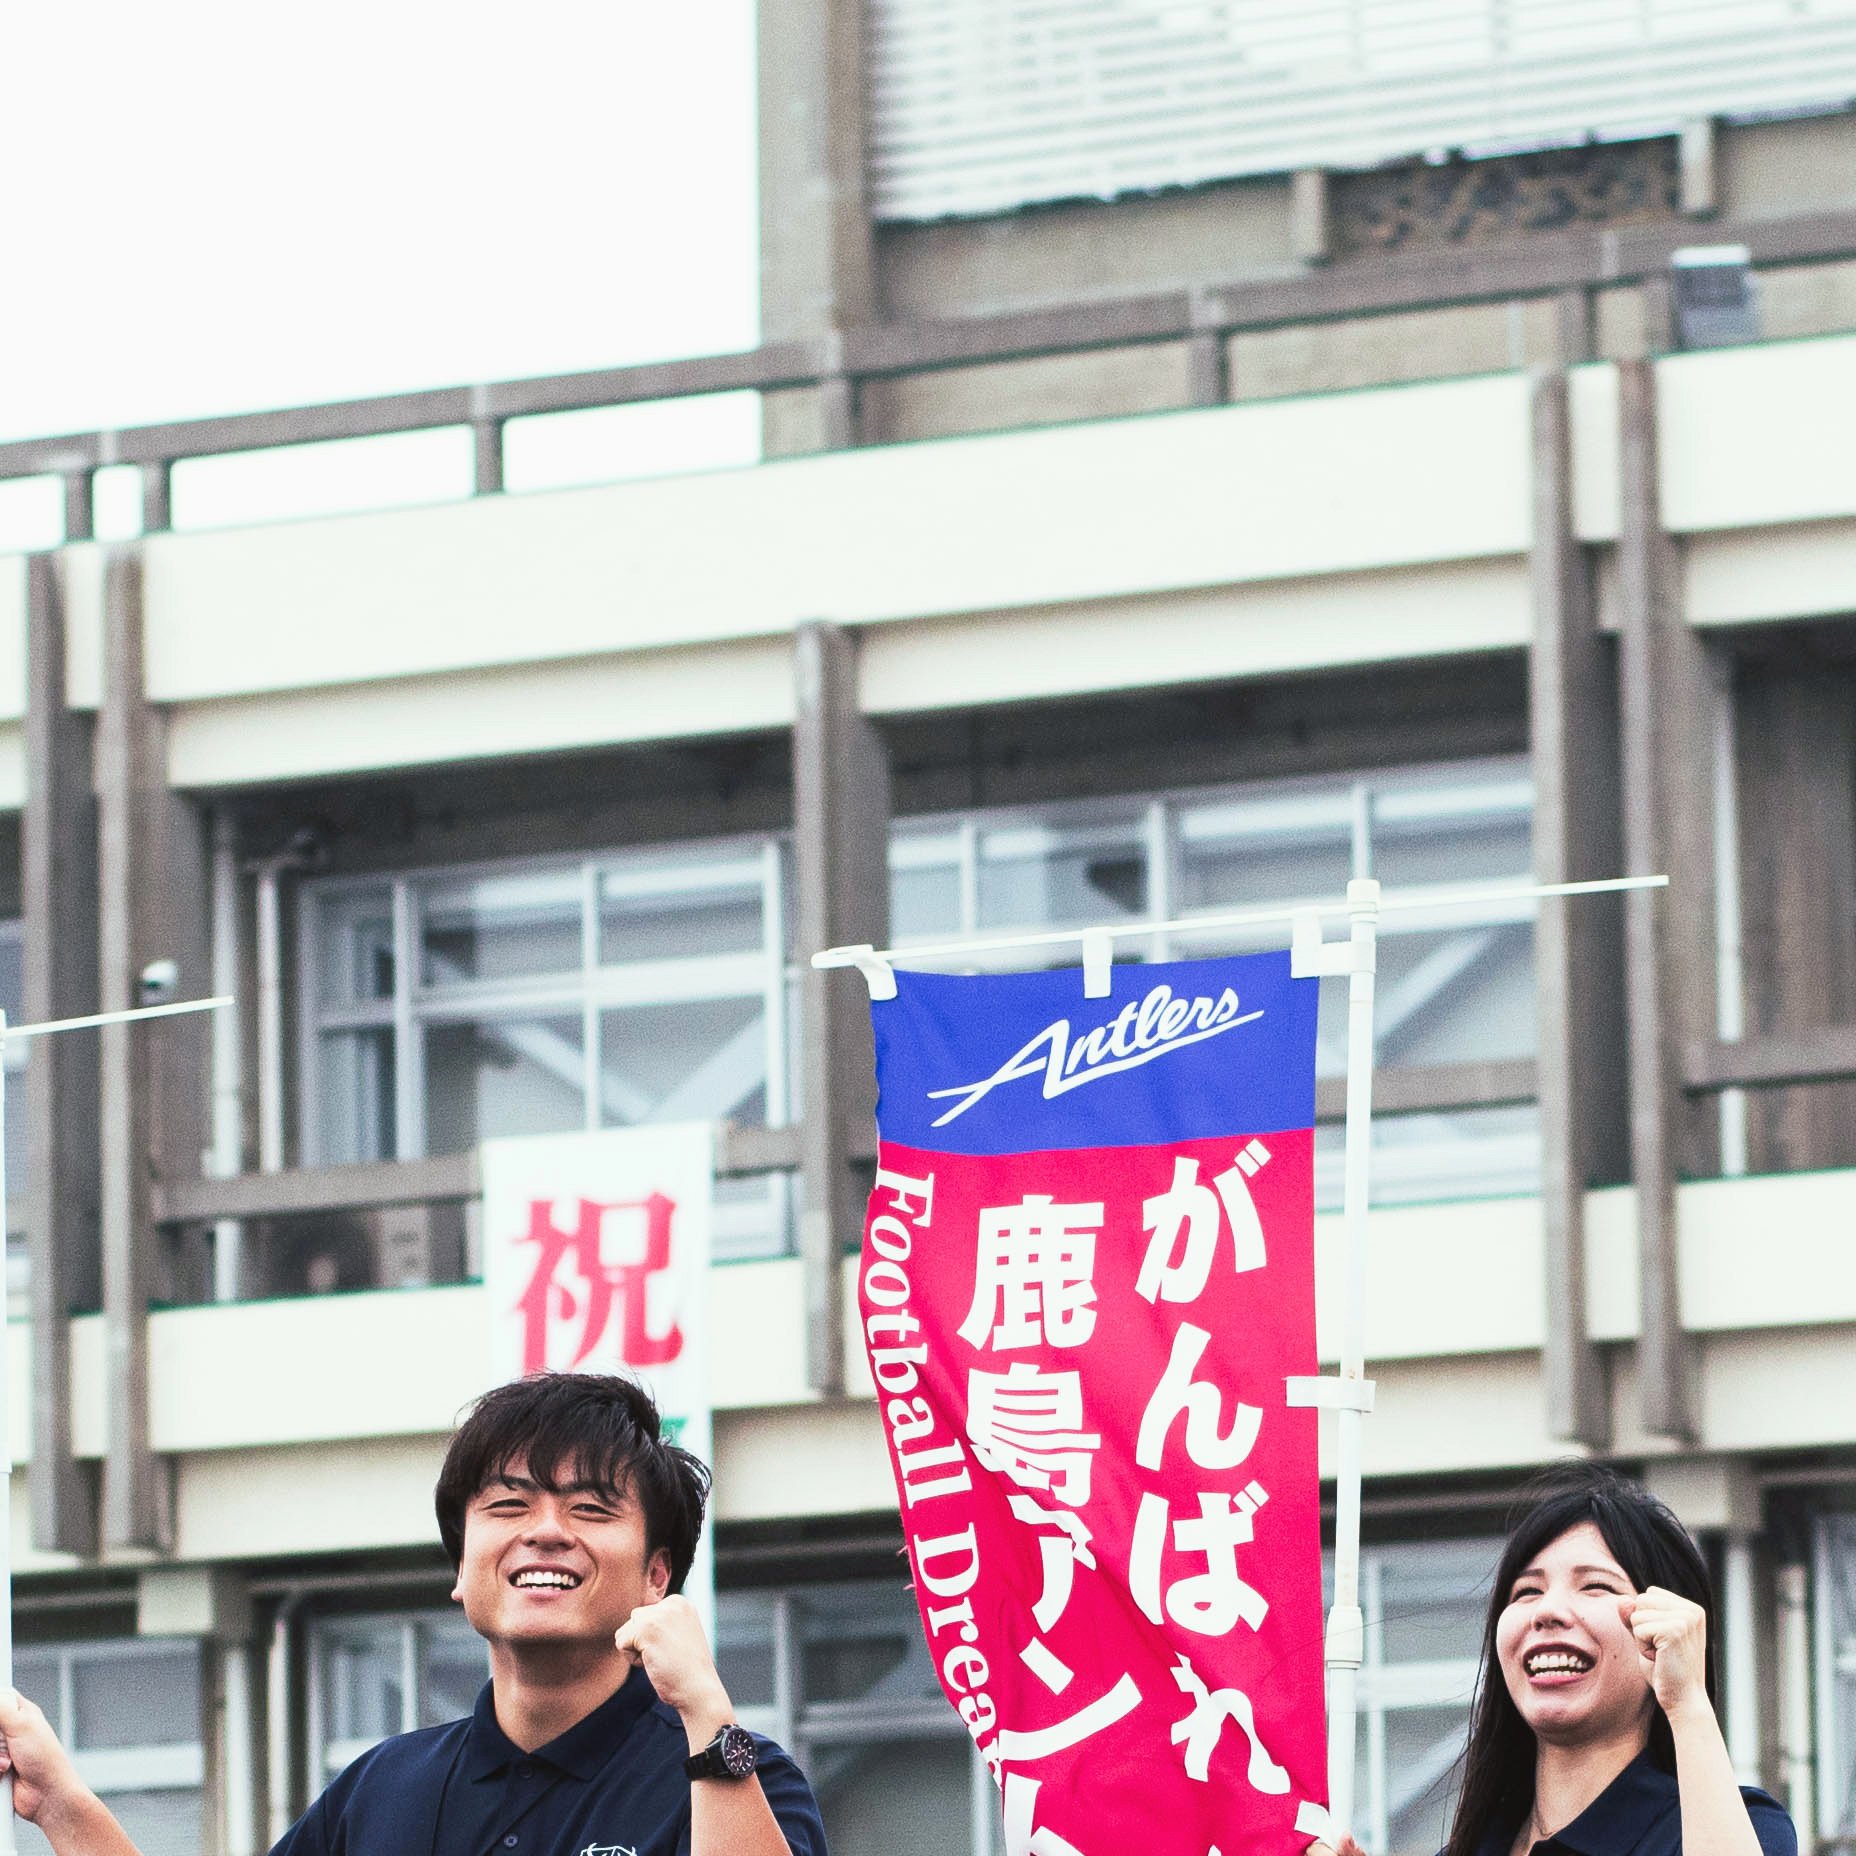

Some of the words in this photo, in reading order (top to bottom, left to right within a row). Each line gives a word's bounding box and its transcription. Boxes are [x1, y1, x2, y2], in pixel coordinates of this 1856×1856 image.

[926, 984, 1265, 1128] Antlers
[509, 1191, 684, 1377] 祝
[864, 1168, 968, 1511] Football
